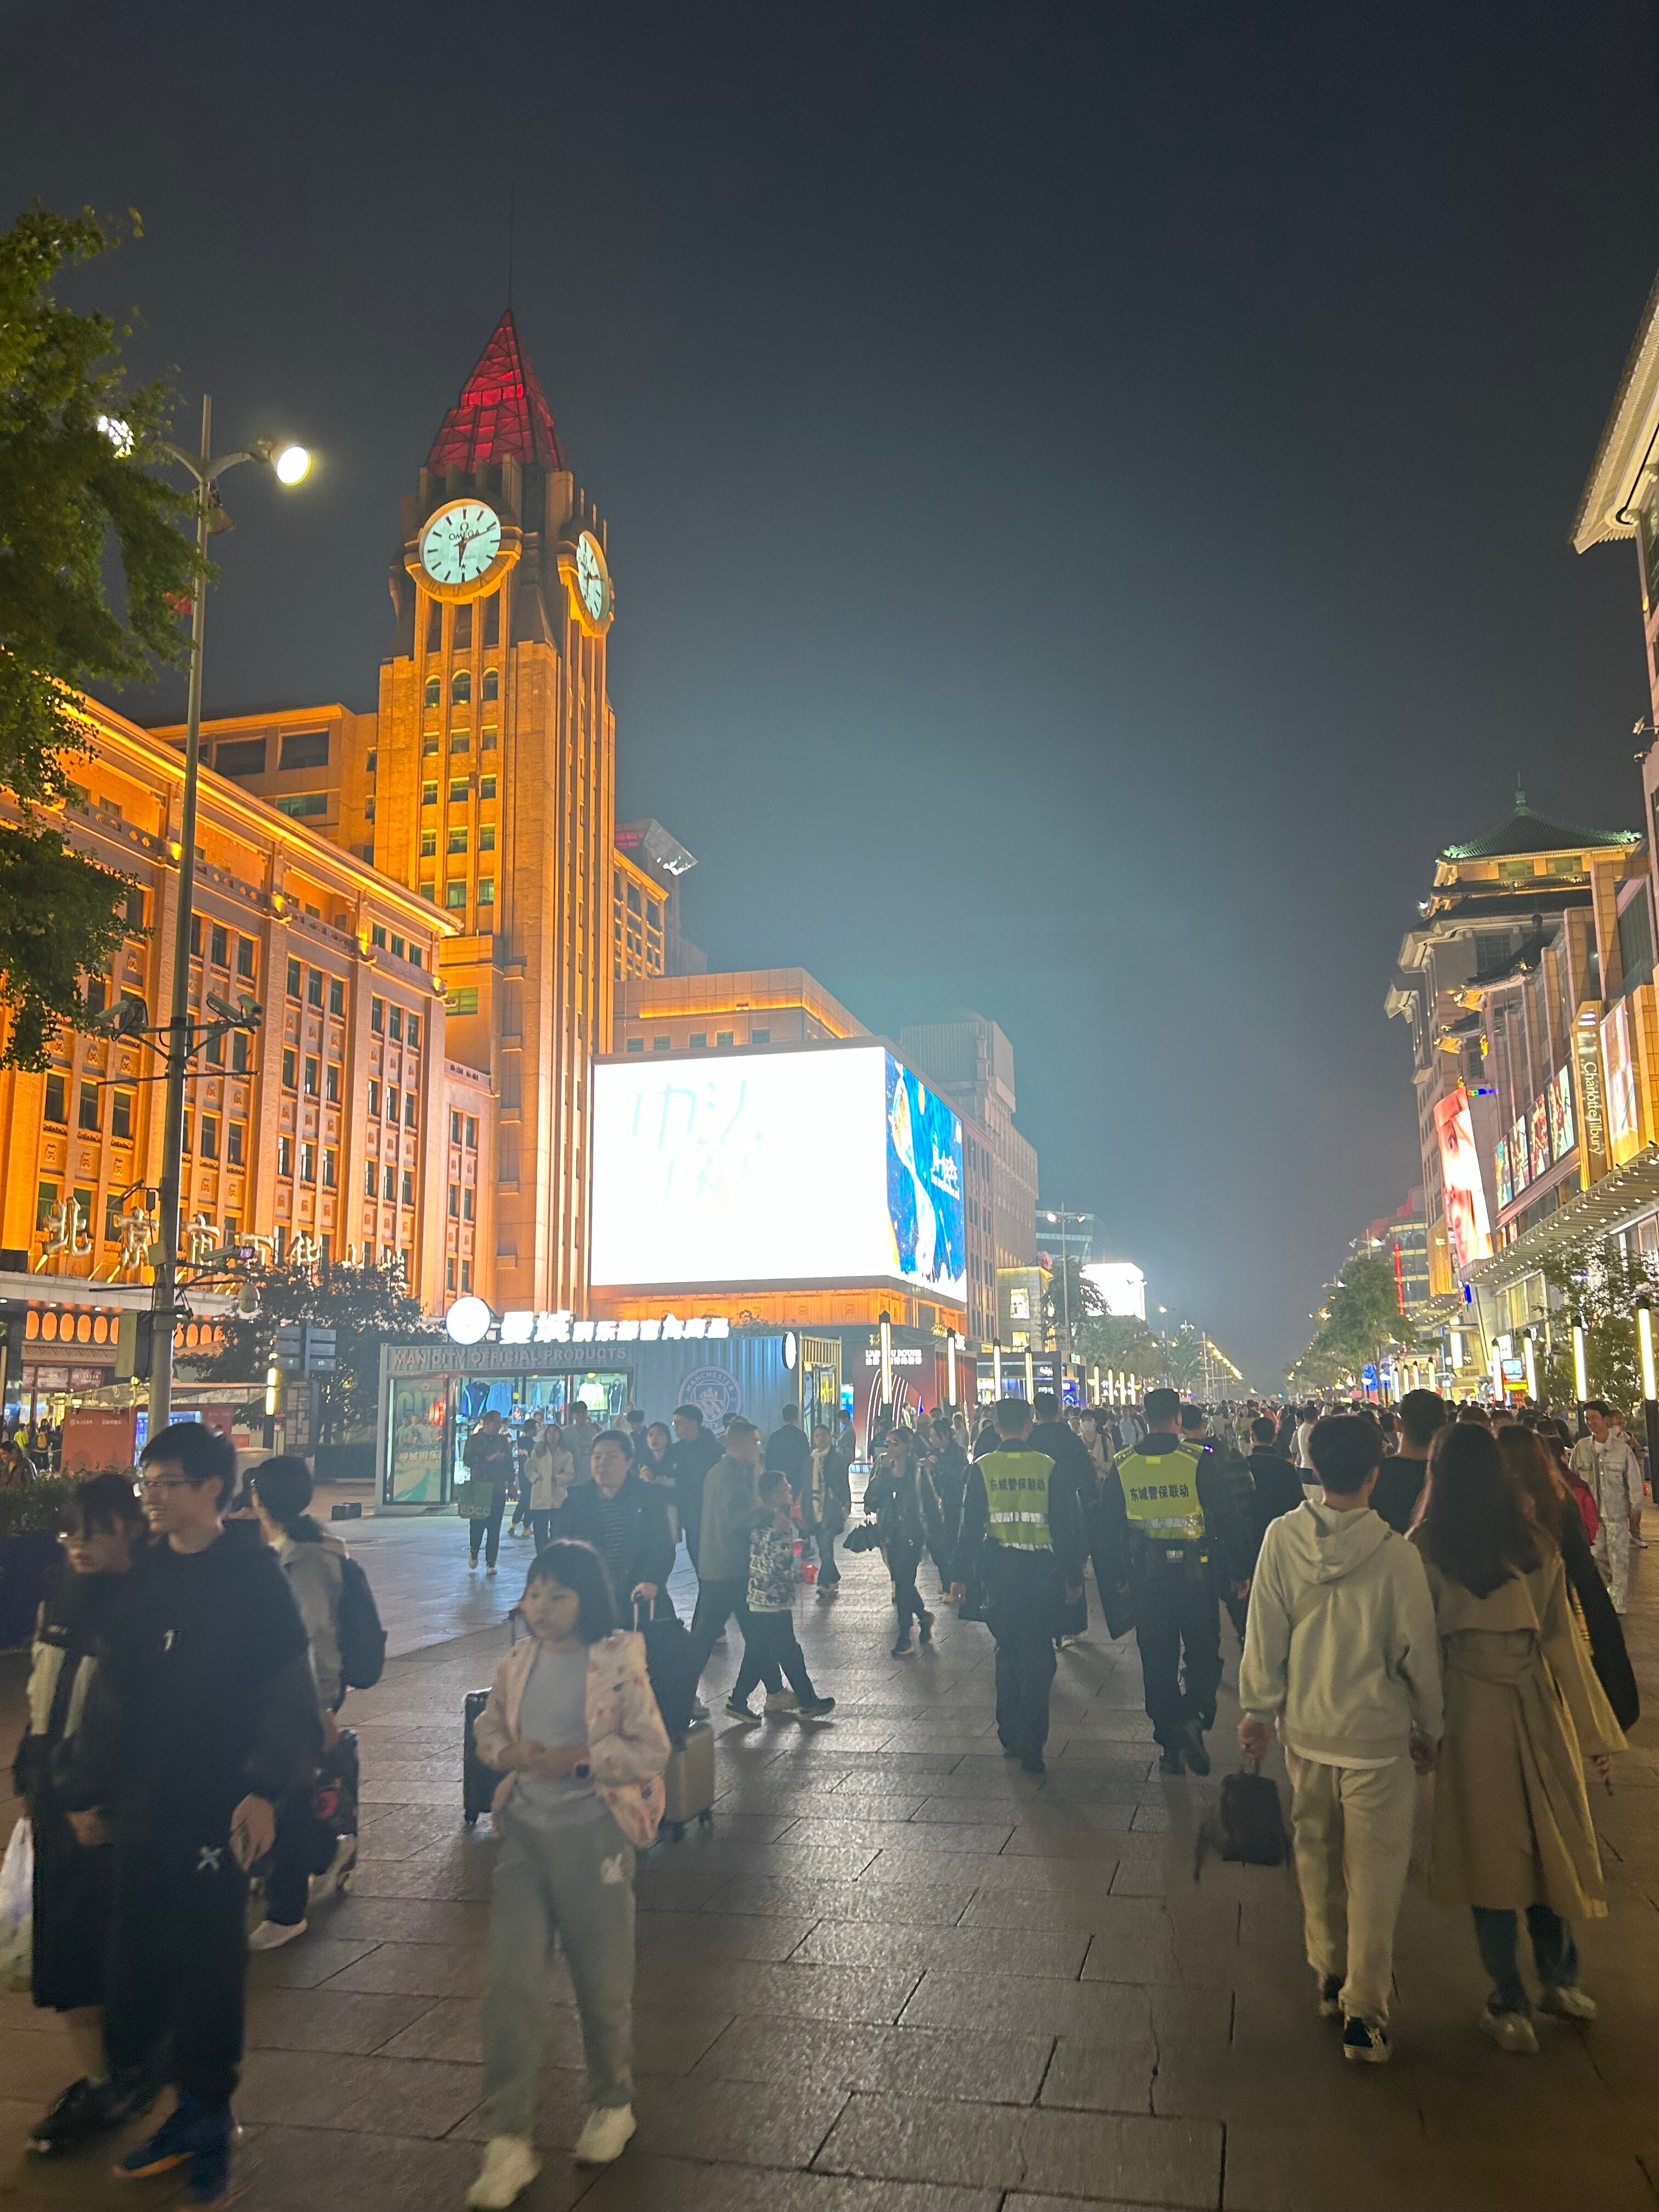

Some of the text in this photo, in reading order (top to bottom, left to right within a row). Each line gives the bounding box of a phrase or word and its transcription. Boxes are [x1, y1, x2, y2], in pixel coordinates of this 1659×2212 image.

[449, 529, 480, 541] OMGA
[394, 1347, 627, 1365] MAN CITY OFFICIAL PRODUCTS
[1130, 1483, 1189, 1501] 东城警保联动
